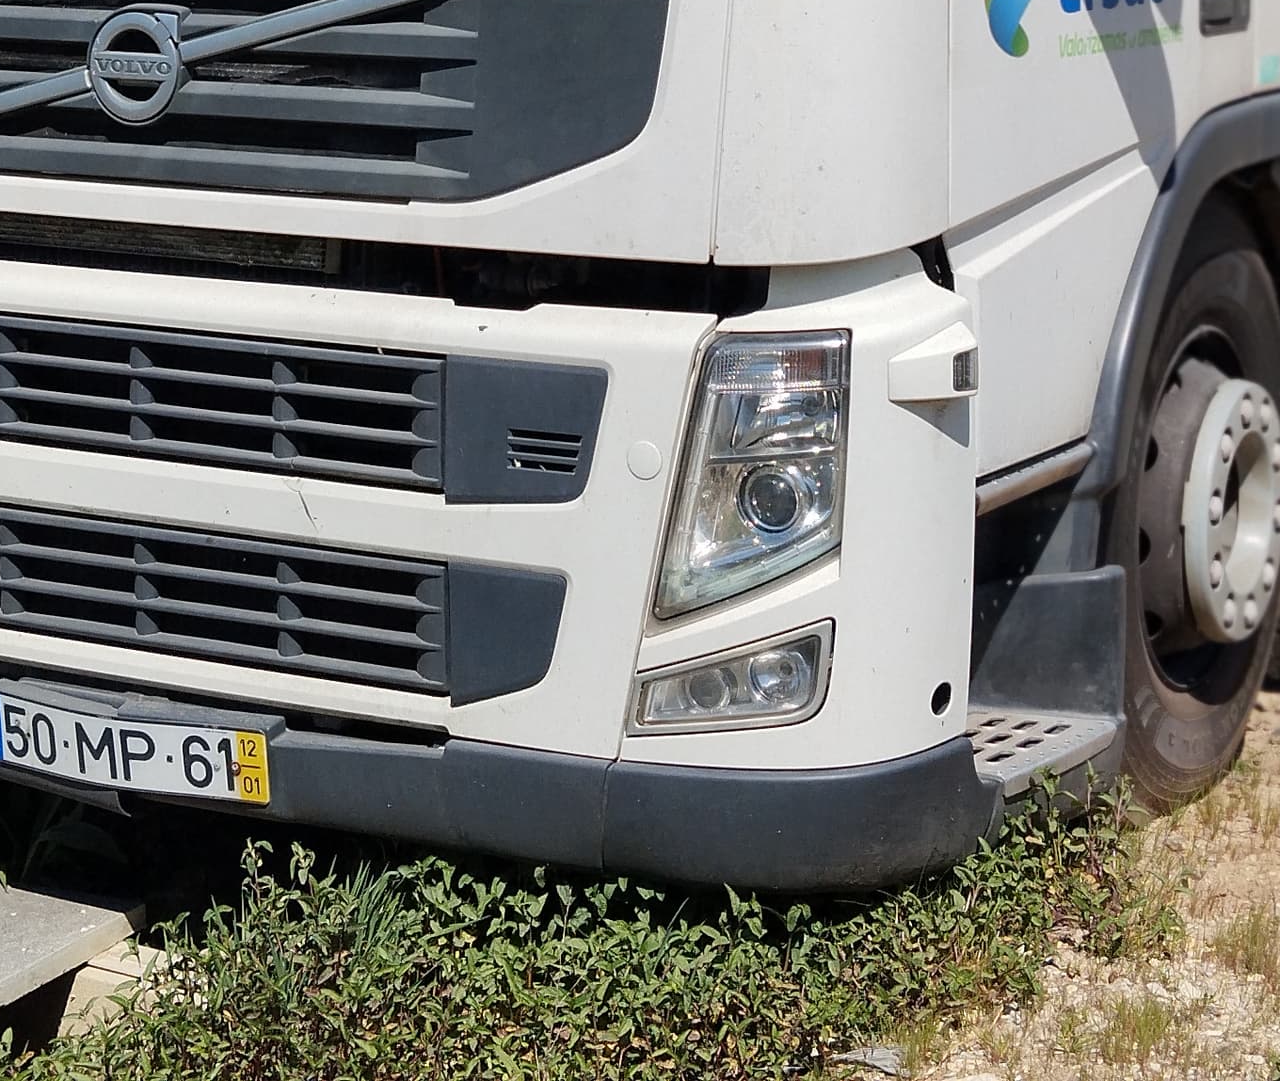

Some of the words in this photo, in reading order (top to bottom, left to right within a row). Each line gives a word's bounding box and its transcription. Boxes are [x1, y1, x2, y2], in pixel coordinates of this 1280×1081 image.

[94, 57, 172, 75] VOLVO
[240, 739, 257, 757] 12
[243, 776, 260, 795] 01
